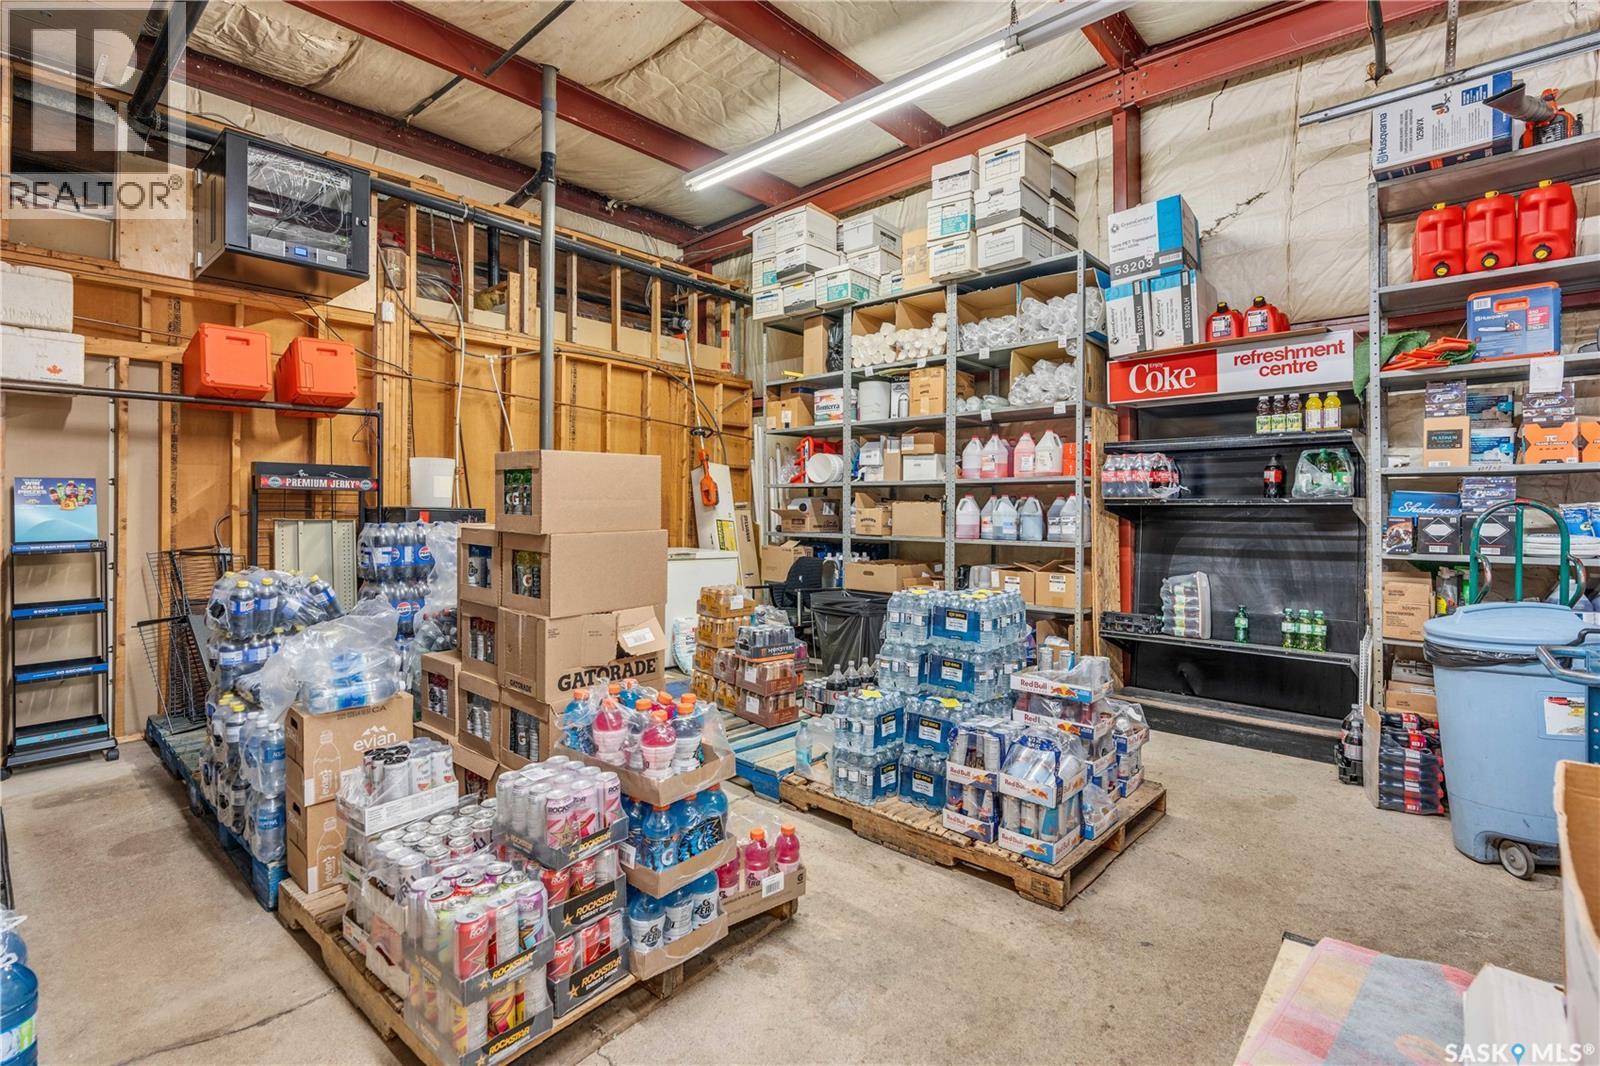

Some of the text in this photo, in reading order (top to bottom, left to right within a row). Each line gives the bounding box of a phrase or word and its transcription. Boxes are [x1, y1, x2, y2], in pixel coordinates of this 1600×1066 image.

[1377, 112, 1388, 156] Husqvarna
[1114, 257, 1153, 276] 53203
[1233, 339, 1345, 367] refreshment
[1129, 363, 1197, 394] Coke
[1259, 358, 1318, 377] centre
[285, 478, 328, 488] PREMIUM
[509, 679, 533, 694] GATORADE
[558, 657, 657, 692] GATORADE
[353, 731, 397, 752] evian
[575, 891, 617, 917] ROCKSTAR
[641, 930, 661, 944] ZERO
[580, 956, 622, 987] ROCKSTAR
[488, 1026, 530, 1056] ROCKSTAR
